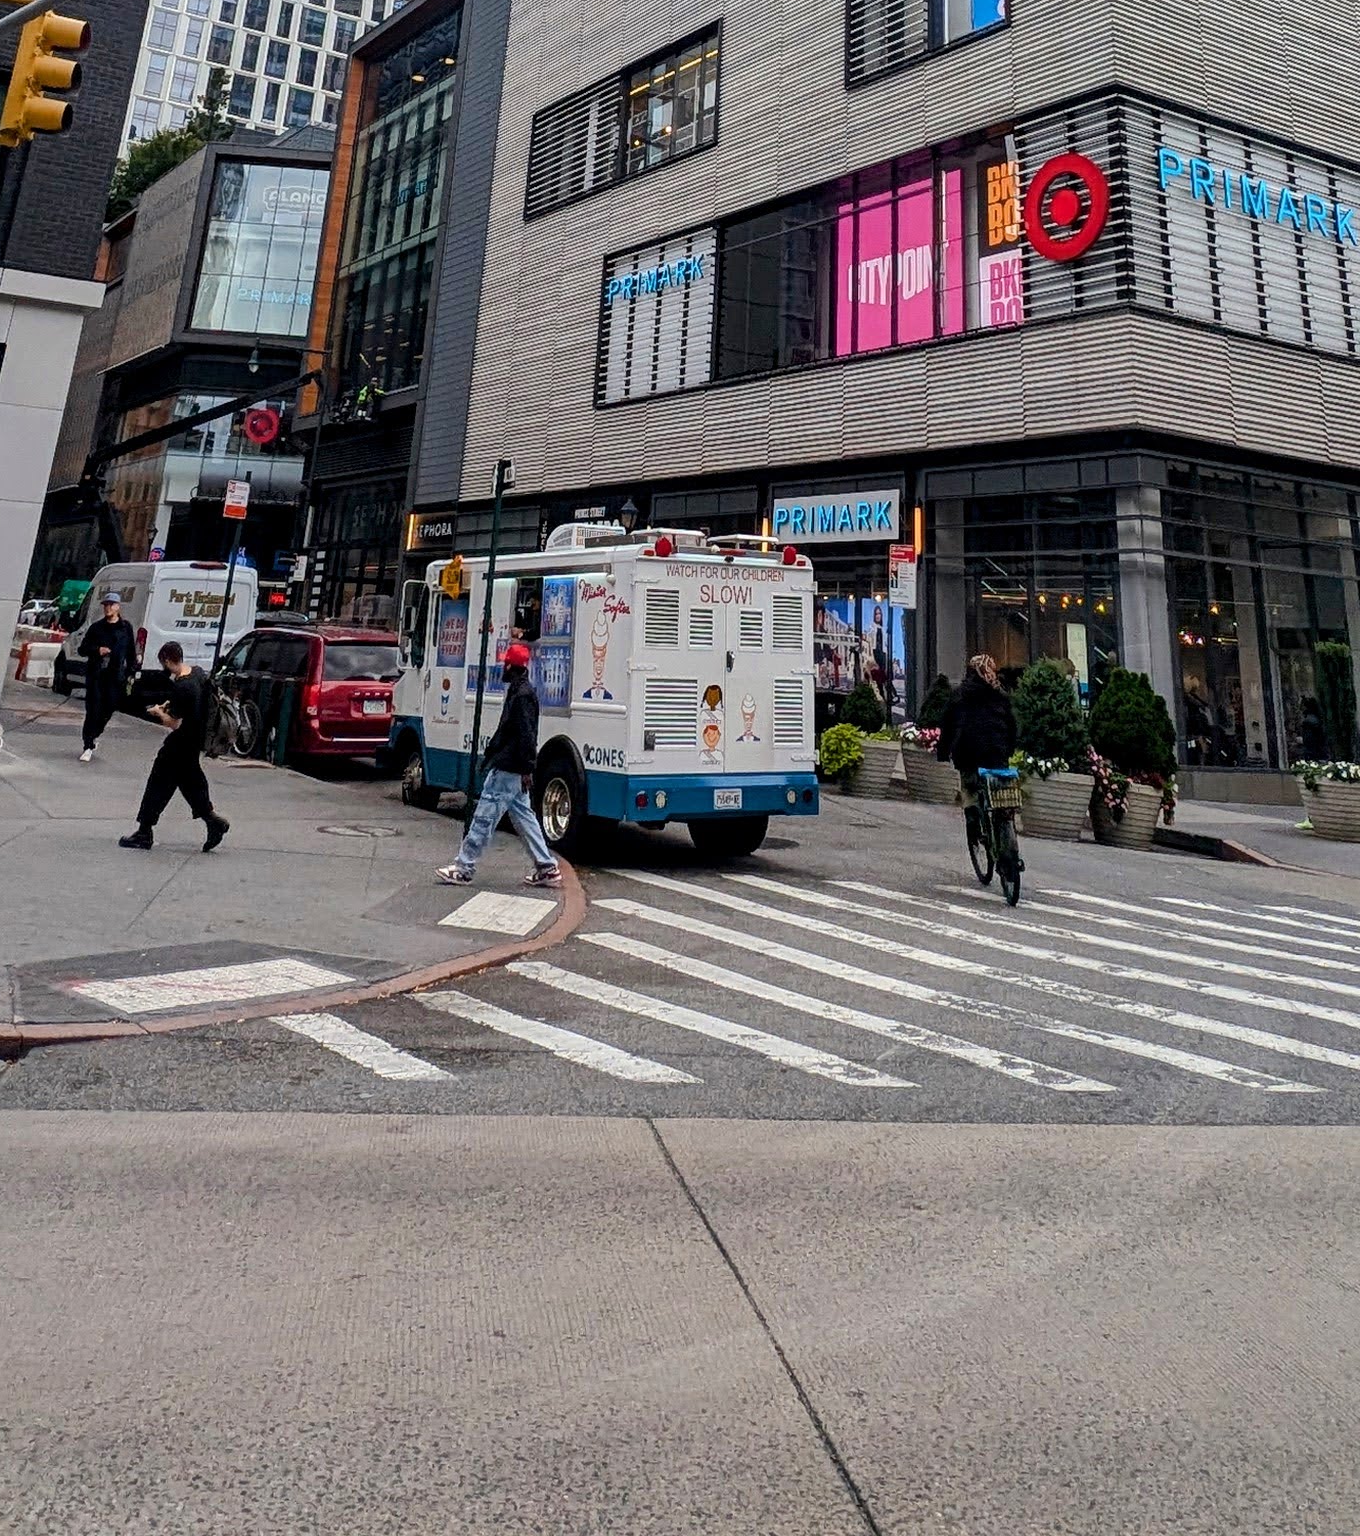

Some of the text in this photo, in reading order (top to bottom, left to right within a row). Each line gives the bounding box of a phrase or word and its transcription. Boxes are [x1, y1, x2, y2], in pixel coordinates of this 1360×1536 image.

[268, 190, 327, 204] ALAMO
[1156, 145, 1359, 247] PRIMARK
[606, 252, 706, 306] PRIMARK
[847, 240, 949, 306] CITYOIN
[238, 288, 313, 307] PRMAR
[773, 500, 893, 536] PRIMARK
[415, 521, 453, 539] SEPHORA
[666, 564, 785, 582] WATCH FOR OUR CHILDREN
[700, 584, 753, 605] SLOW!
[463, 734, 491, 750] SHKE
[589, 746, 625, 768] CONES
